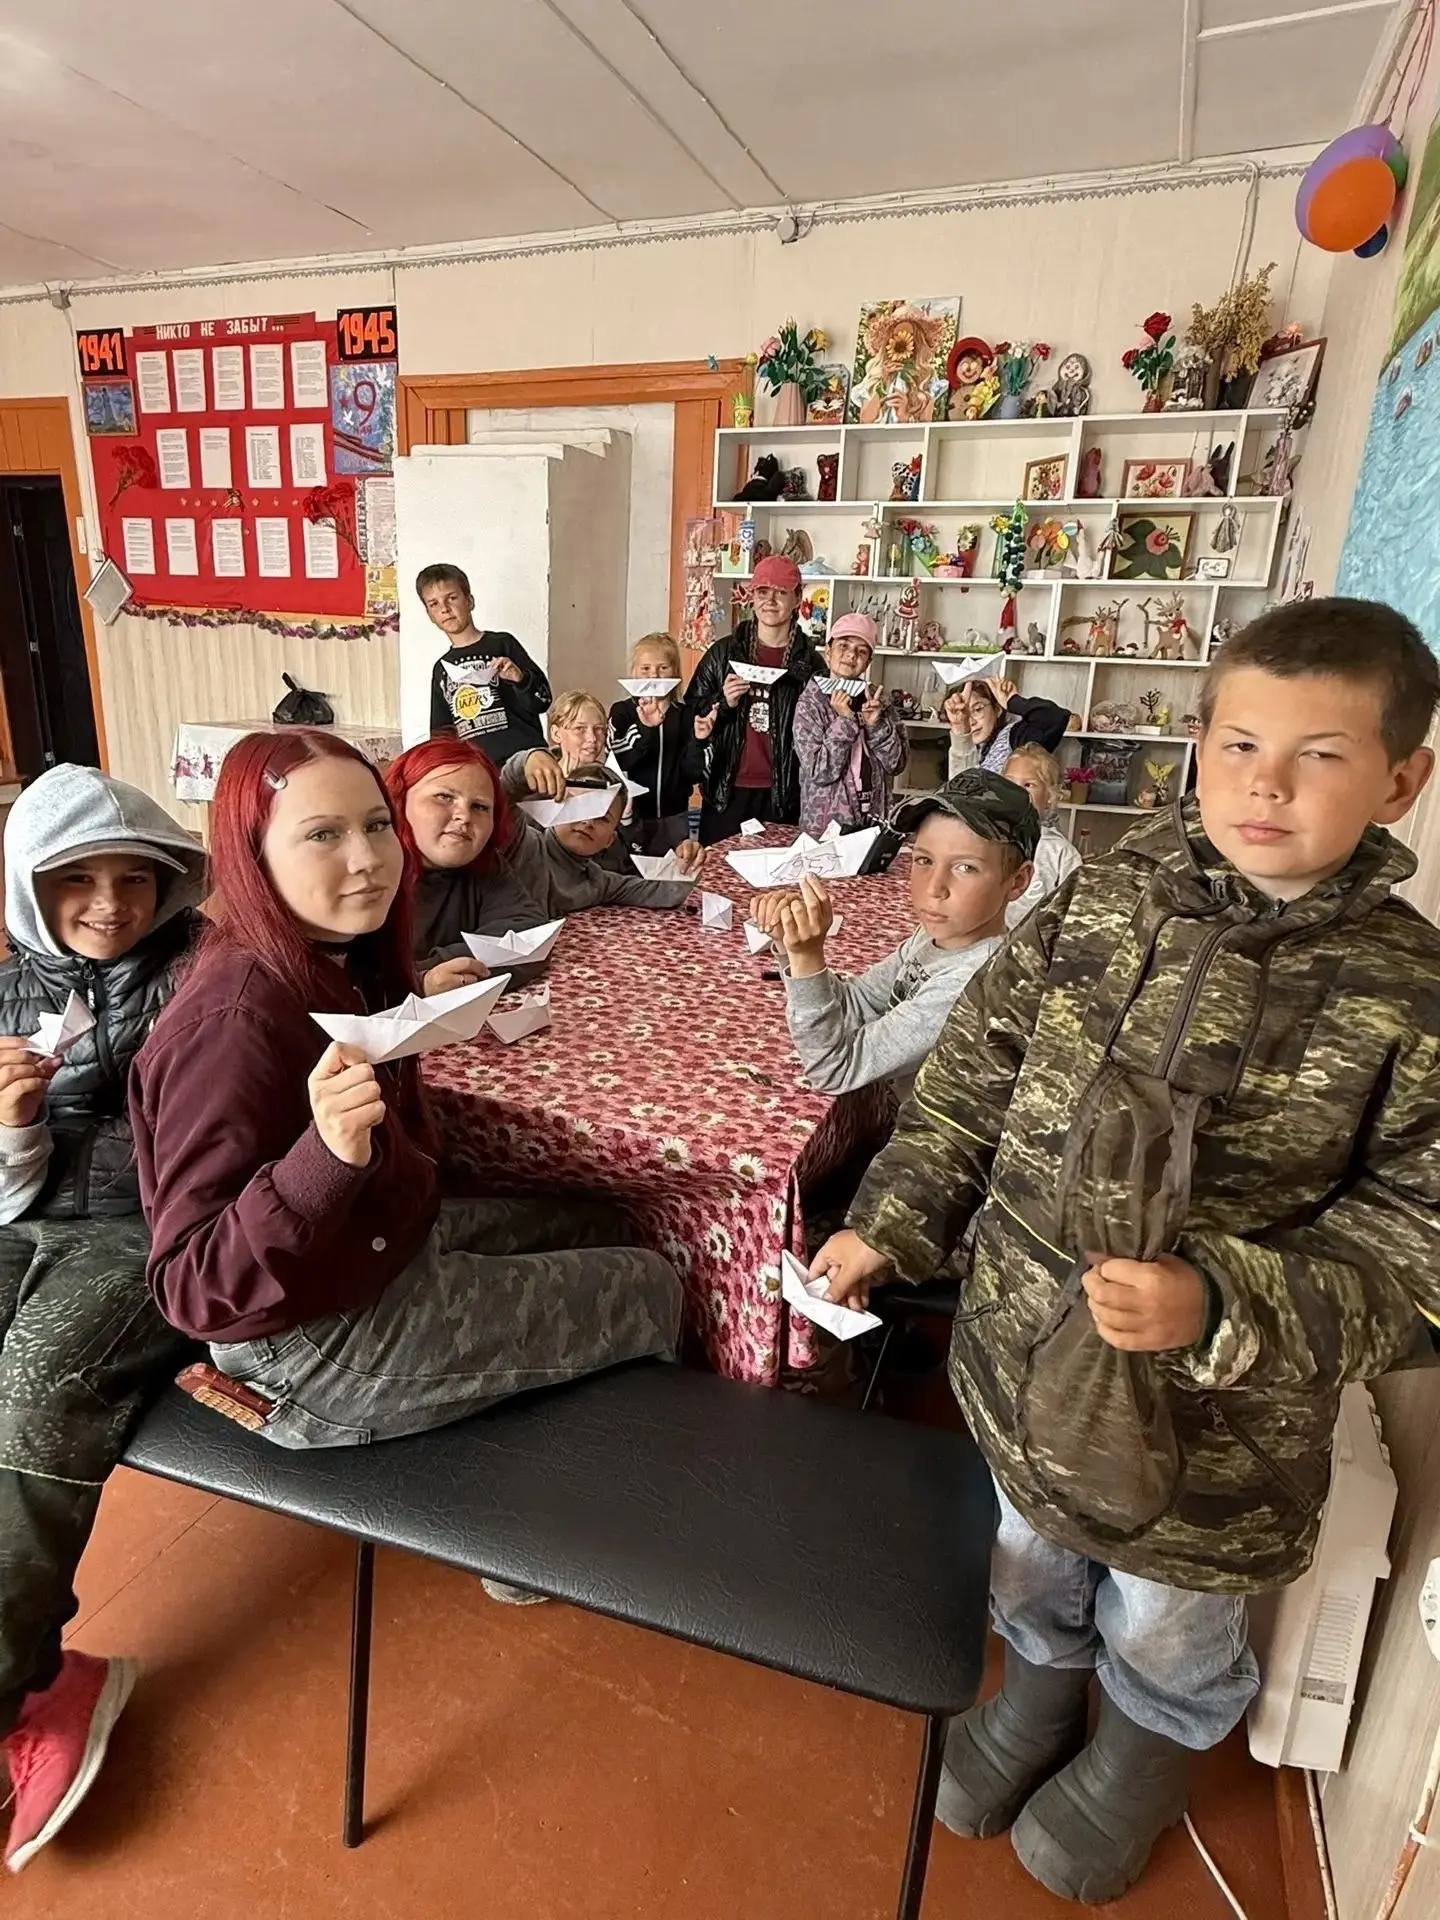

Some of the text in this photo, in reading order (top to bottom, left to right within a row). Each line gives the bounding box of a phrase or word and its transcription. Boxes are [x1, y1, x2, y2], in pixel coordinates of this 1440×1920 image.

[79, 332, 124, 371] 1941
[156, 324, 190, 340] НИКТО
[200, 322, 215, 336] НЕ
[339, 311, 395, 355] 1945
[353, 380, 377, 426] 9
